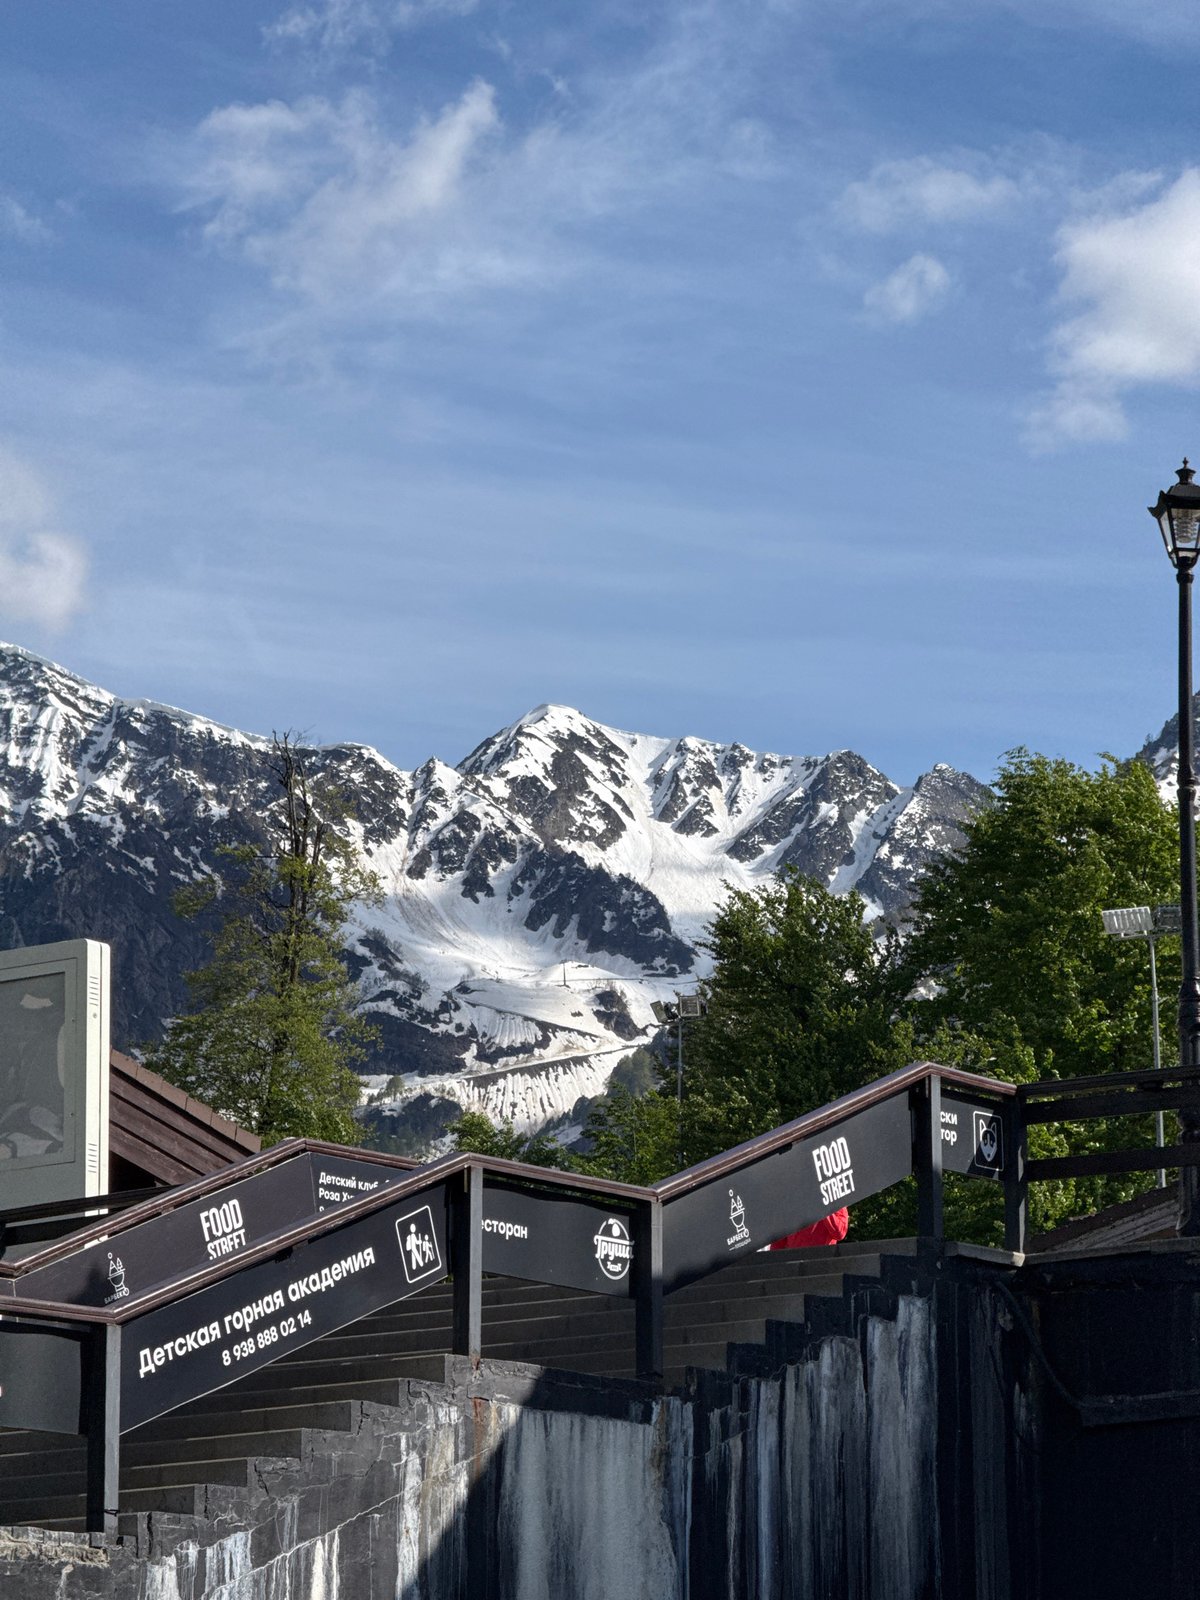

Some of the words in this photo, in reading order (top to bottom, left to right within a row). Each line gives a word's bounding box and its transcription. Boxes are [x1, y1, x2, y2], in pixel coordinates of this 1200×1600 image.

[812, 1136, 851, 1182] FOOD
[319, 1172, 357, 1189] Детский
[319, 1187, 341, 1202] Роза
[820, 1169, 856, 1206] STREET
[200, 1198, 243, 1242] FOOD
[207, 1228, 246, 1260] STREET
[138, 1320, 222, 1379] Детская
[224, 1290, 285, 1334] горная
[287, 1247, 376, 1302] академия
[221, 1350, 232, 1367] 8
[232, 1337, 256, 1361] 938
[257, 1325, 279, 1349] 888
[279, 1316, 297, 1337] 02
[297, 1309, 312, 1328] 14
